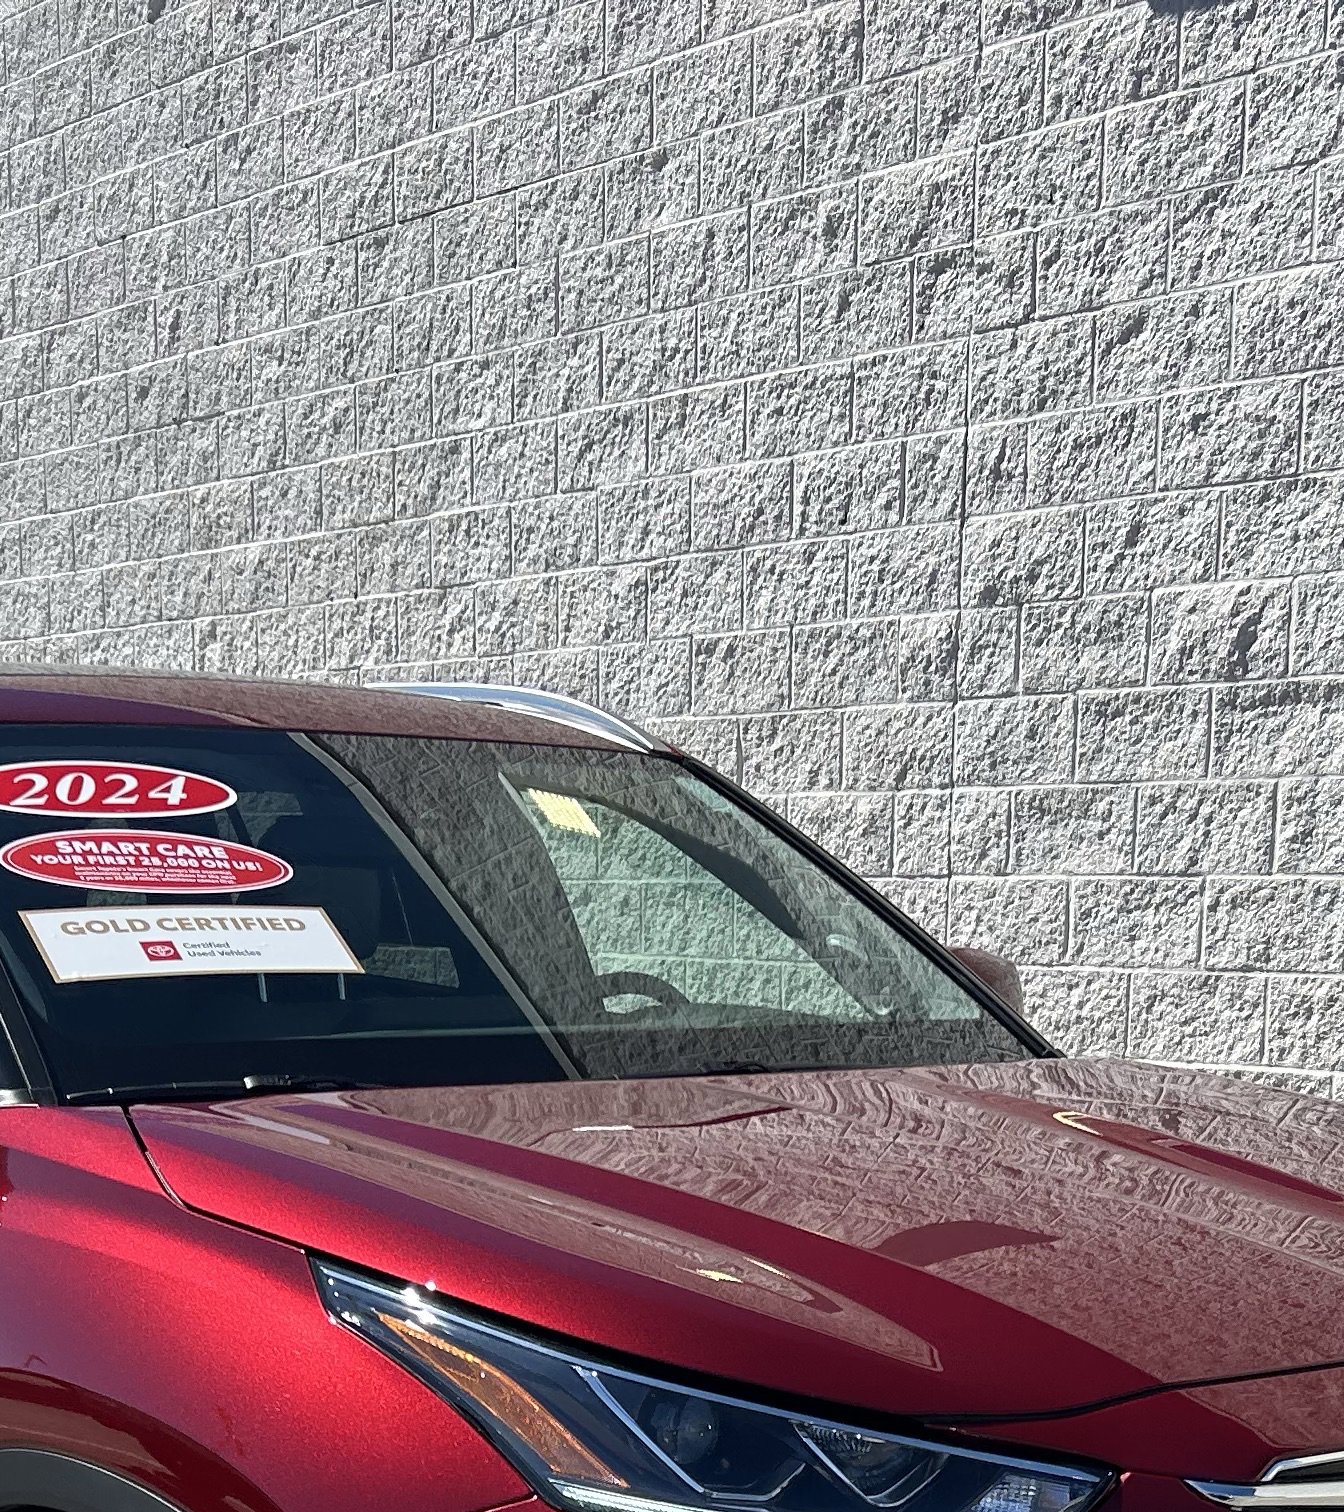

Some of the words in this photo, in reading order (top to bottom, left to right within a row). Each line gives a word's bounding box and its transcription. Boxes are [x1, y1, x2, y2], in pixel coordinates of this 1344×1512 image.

[9, 772, 188, 806] 2024
[55, 840, 150, 856] SMART
[156, 844, 229, 859] CARE
[30, 854, 85, 865] YOUR
[86, 855, 136, 865] FIRST
[201, 859, 231, 869] ON
[231, 860, 263, 872] US!
[60, 918, 151, 935] GOLD
[156, 917, 306, 932] CERTIFIED
[182, 941, 230, 949] Certified
[218, 949, 262, 957] Vehicles
